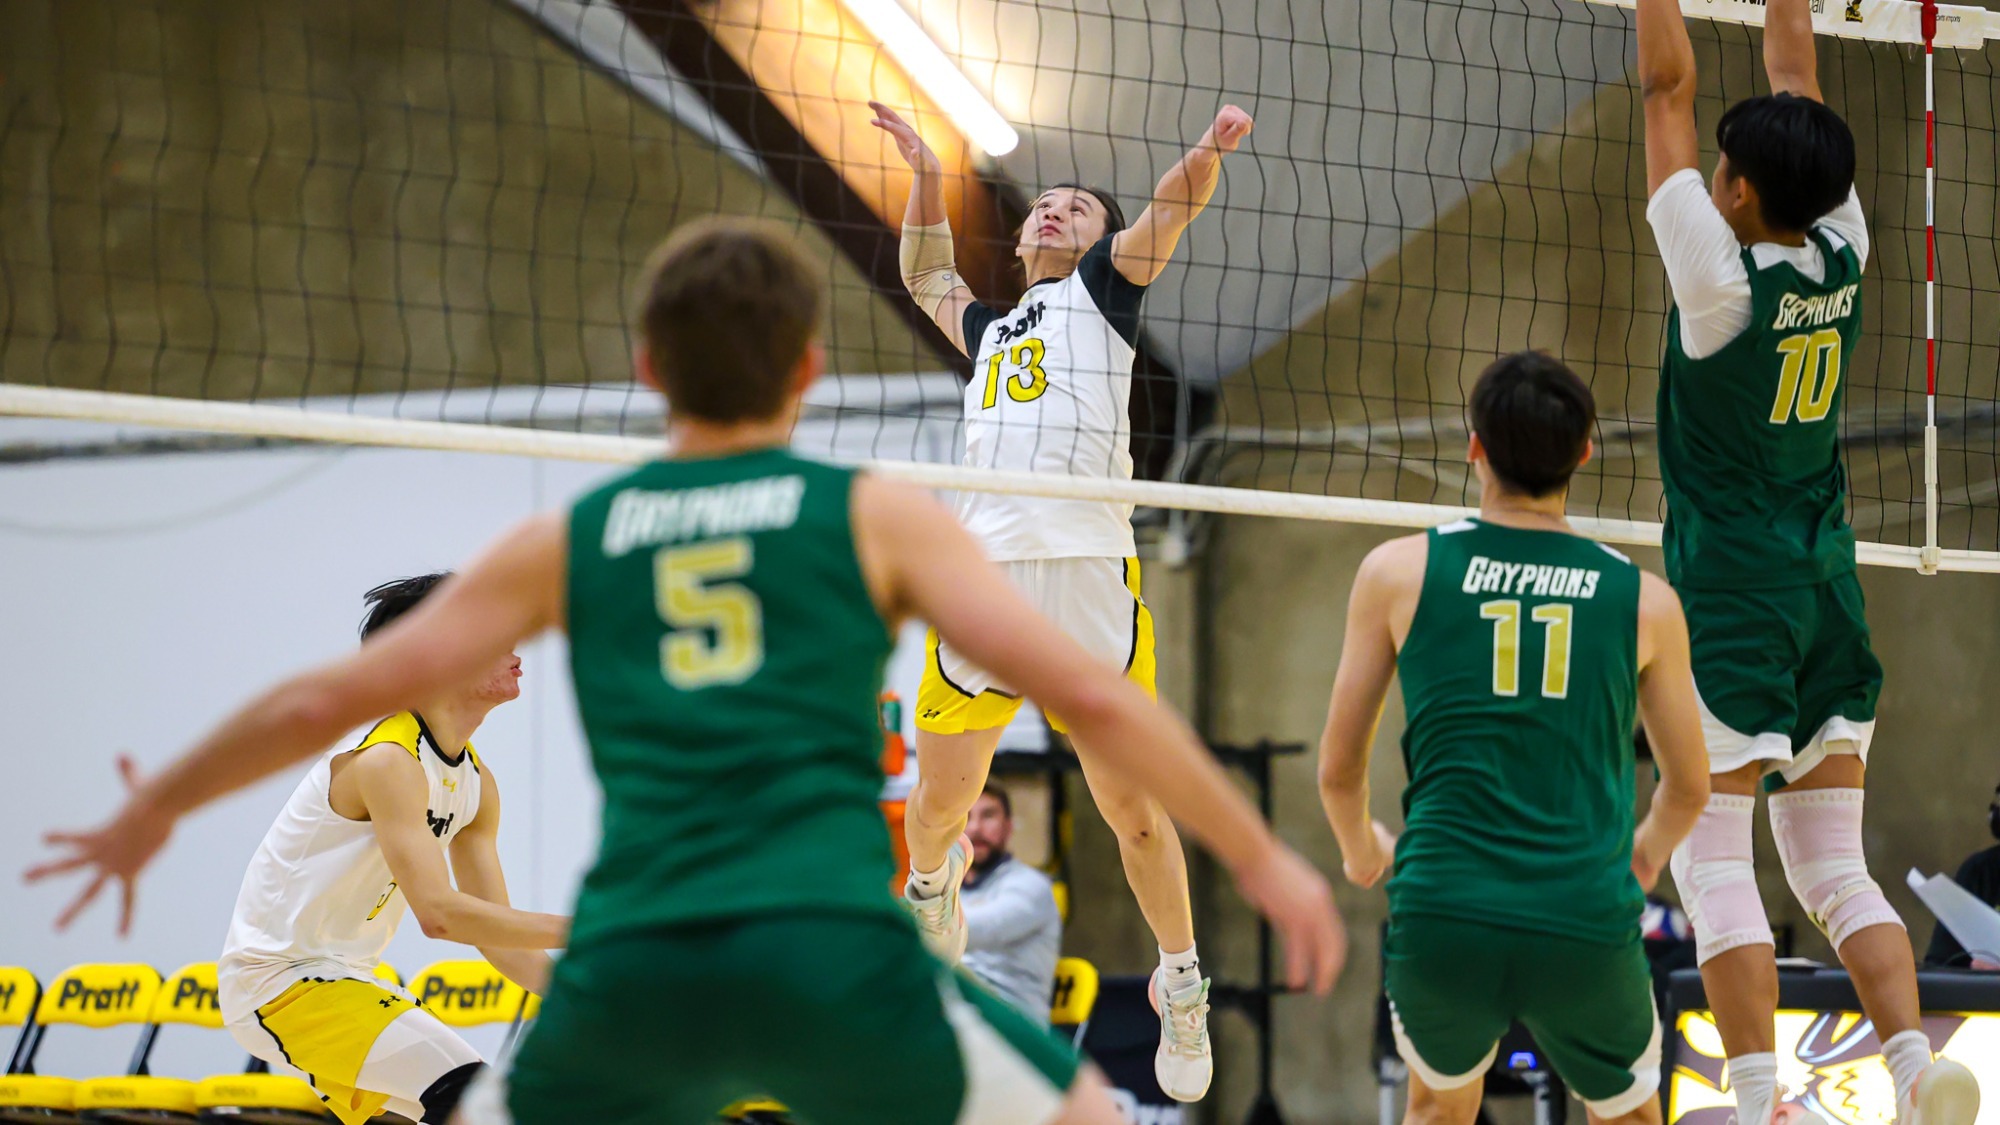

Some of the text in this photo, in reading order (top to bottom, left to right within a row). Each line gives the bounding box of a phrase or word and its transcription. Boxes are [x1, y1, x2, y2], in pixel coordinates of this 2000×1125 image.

[1772, 284, 1858, 330] GRYPHONS
[982, 338, 1049, 410] 13
[1769, 328, 1841, 425] 10
[602, 475, 806, 558] GRYPHONS
[1462, 555, 1600, 599] GRYPHONS
[653, 535, 764, 690] 5
[1479, 599, 1573, 700] 11
[58, 978, 140, 1011] Pratt
[173, 977, 219, 1011] Pra
[422, 975, 505, 1010] Pratt
